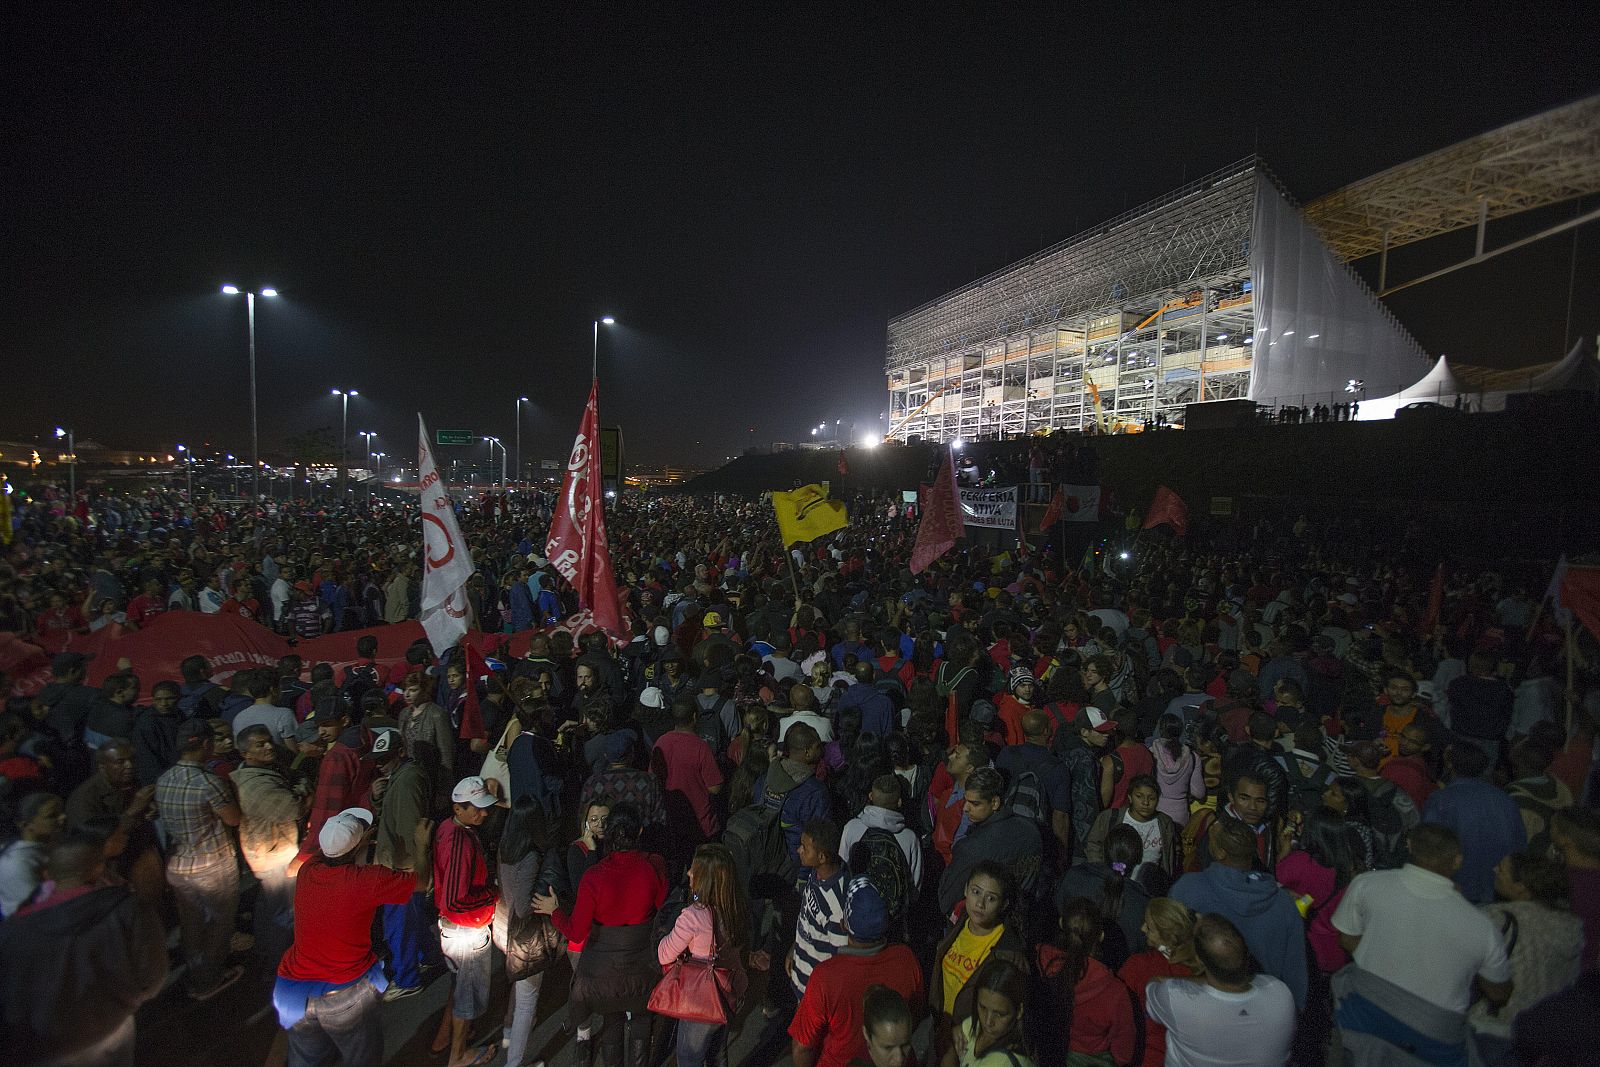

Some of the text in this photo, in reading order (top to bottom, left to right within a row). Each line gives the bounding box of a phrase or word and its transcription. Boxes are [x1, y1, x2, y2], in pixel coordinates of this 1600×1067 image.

[960, 490, 1015, 503] PERIFERIA
[973, 503, 1002, 515] ATIVA
[997, 517, 1015, 527] LUTA
